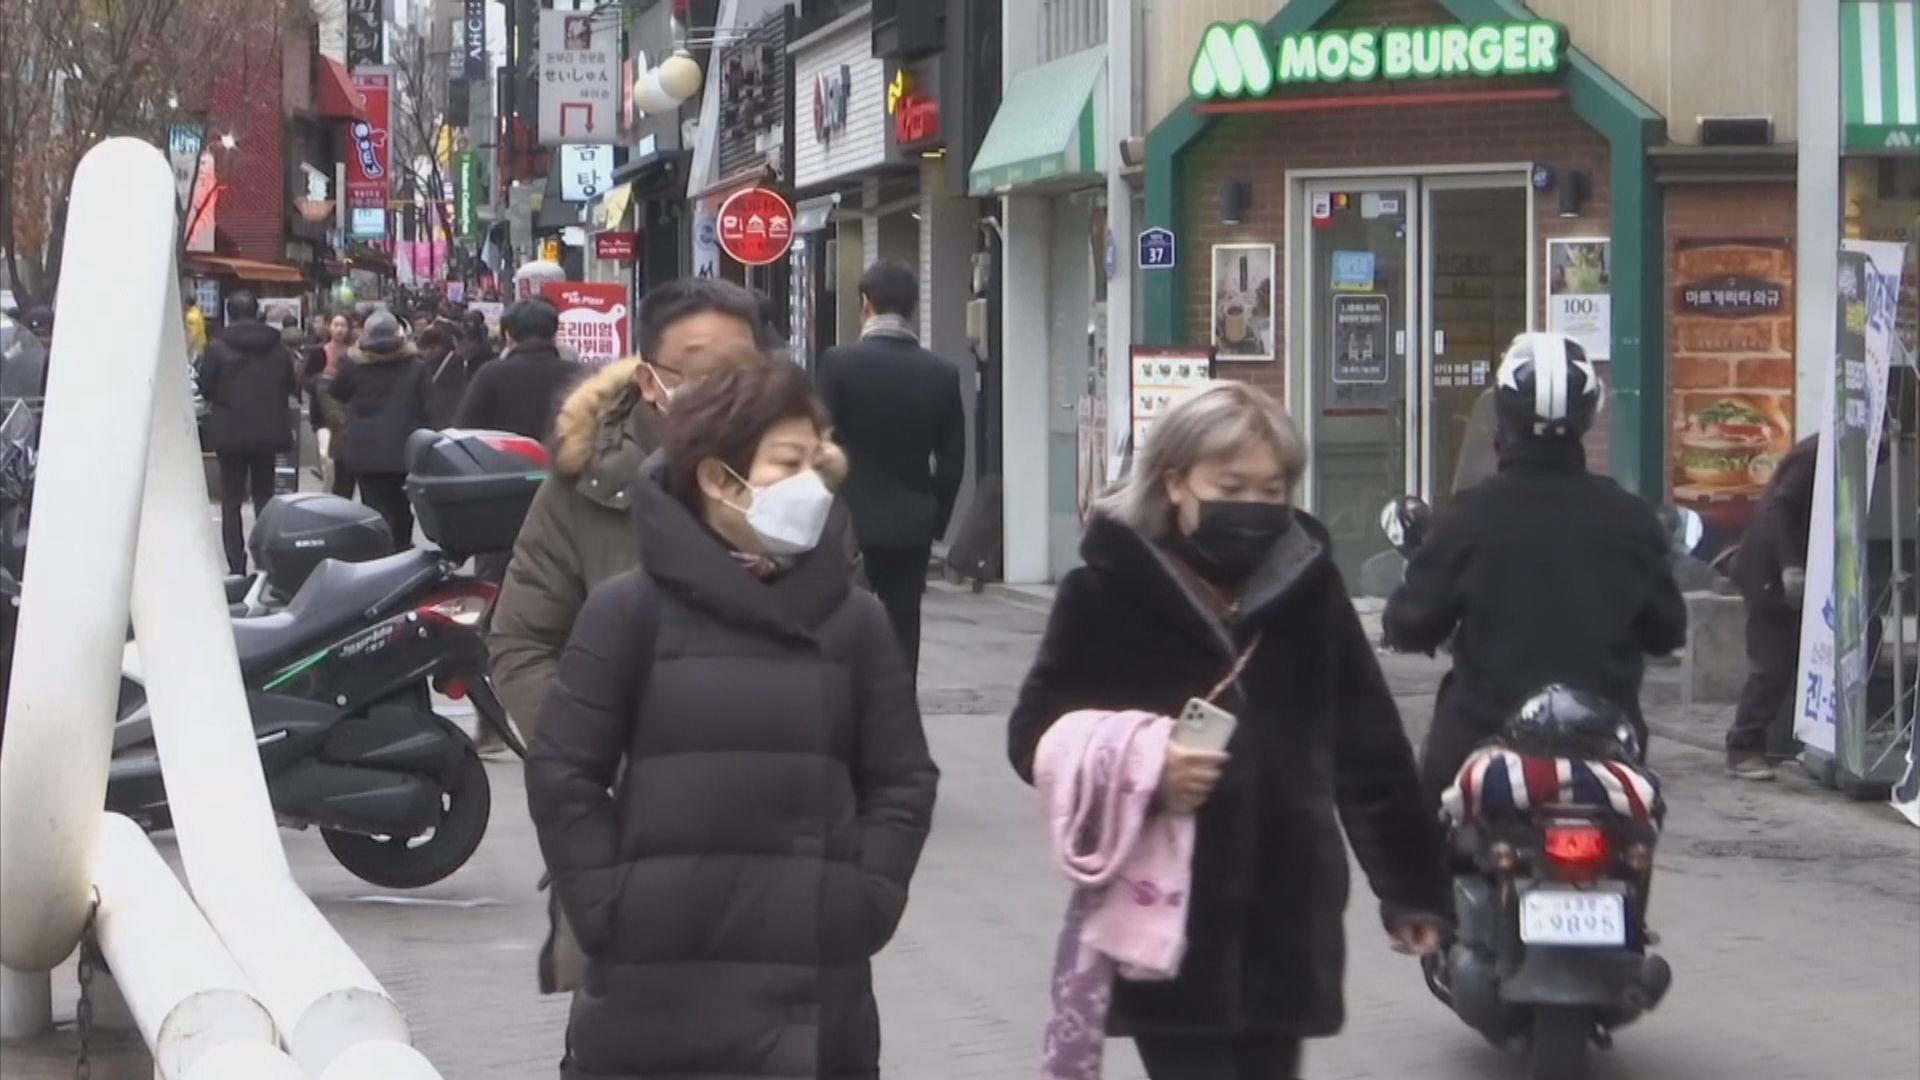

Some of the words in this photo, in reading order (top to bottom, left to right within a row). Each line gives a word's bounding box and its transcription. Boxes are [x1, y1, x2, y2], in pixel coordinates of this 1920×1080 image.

[1278, 36, 1377, 80] MOS
[1384, 28, 1557, 74] BURGER
[545, 67, 609, 83] せいしゅん
[723, 213, 789, 240] 민속촌
[1149, 247, 1164, 263] 37
[1549, 913, 1615, 937] 9895
